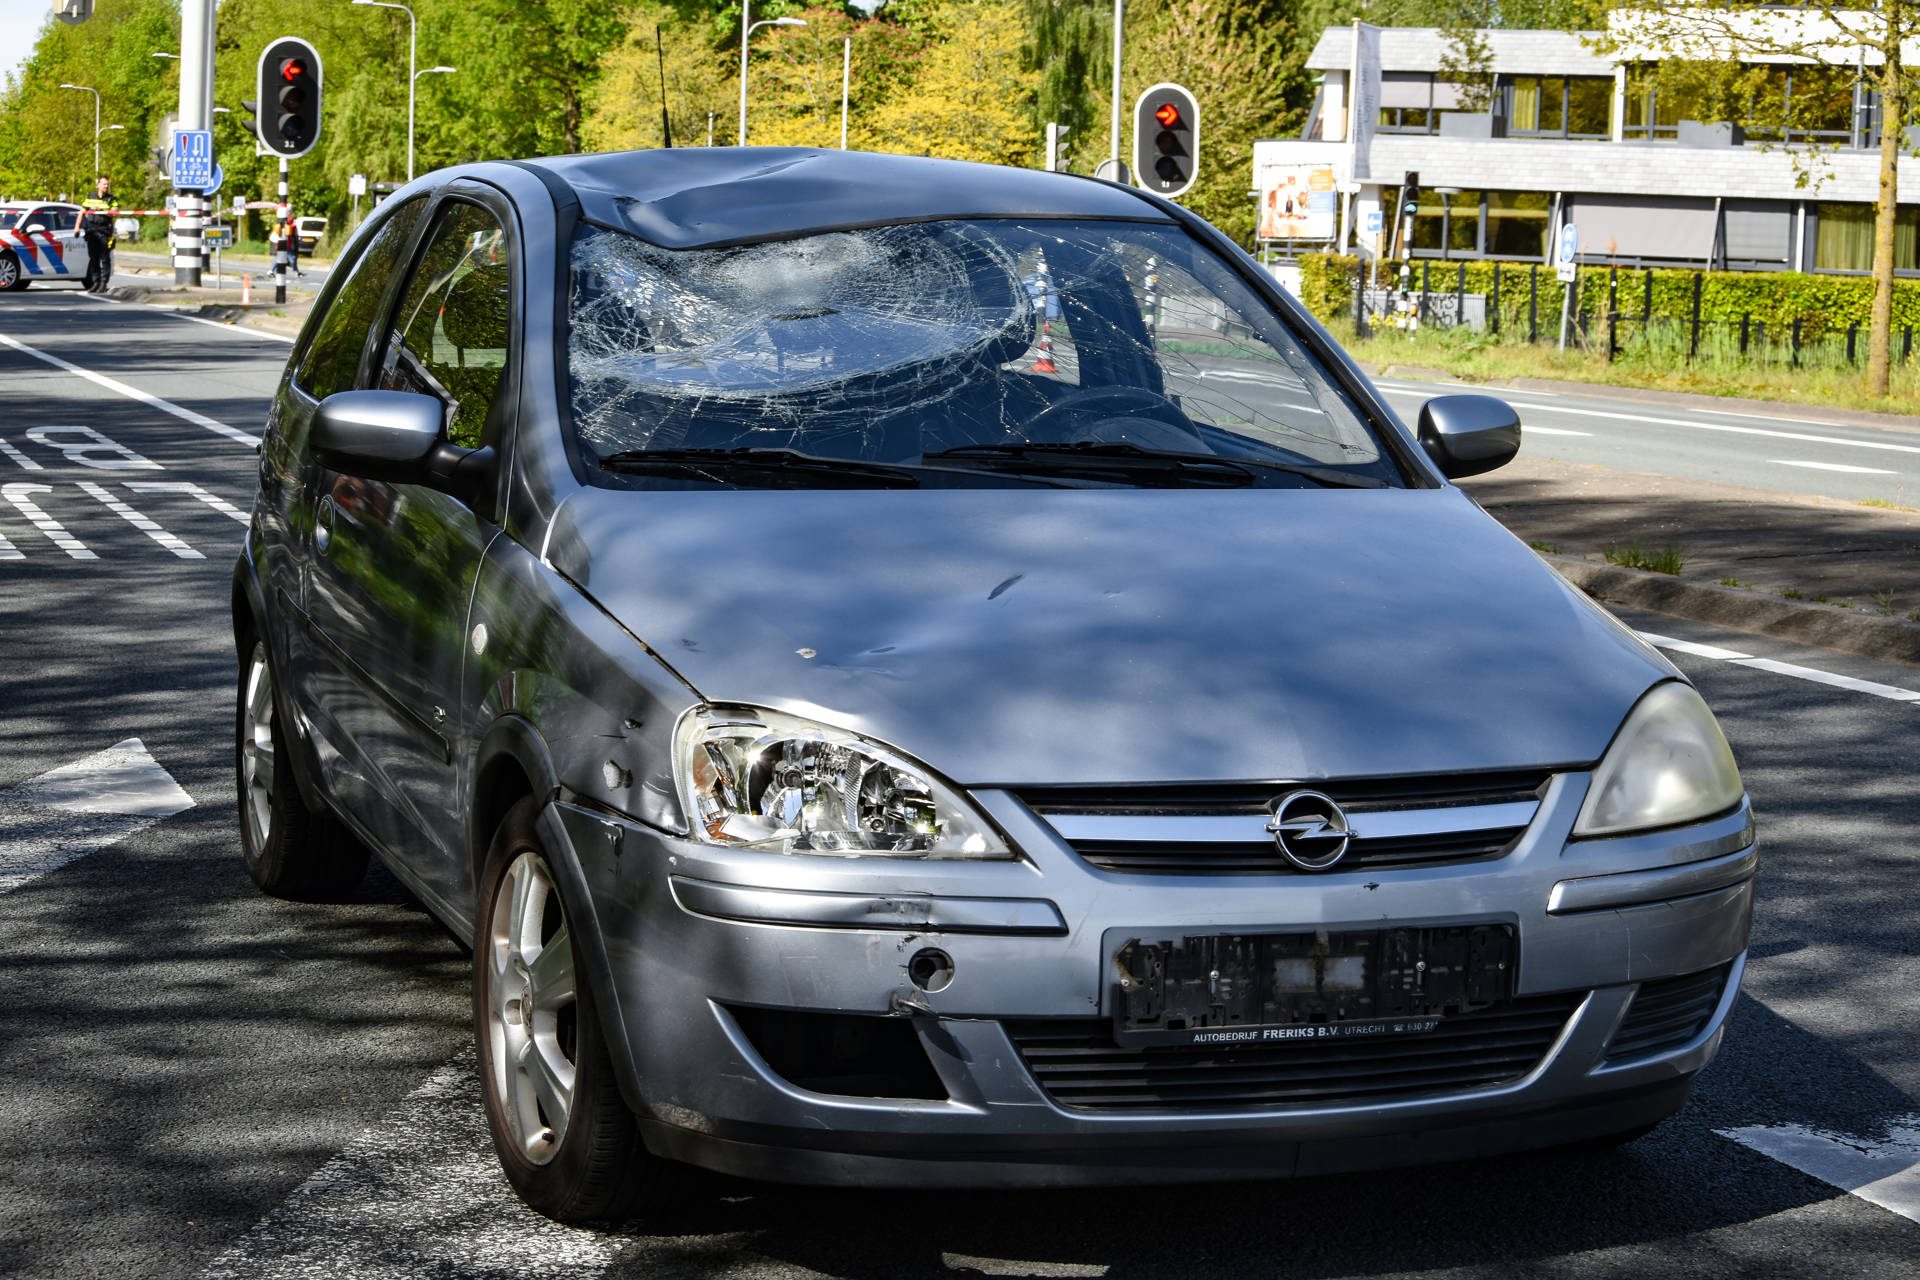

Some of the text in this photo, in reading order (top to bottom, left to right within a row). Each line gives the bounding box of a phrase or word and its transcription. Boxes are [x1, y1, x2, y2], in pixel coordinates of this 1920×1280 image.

[176, 176, 208, 184] LET OP
[0, 482, 252, 559] LIJ
[1193, 1031, 1259, 1042] AUTOBEDRIJF
[1263, 1027, 1315, 1039] FRERIKS
[1344, 1025, 1385, 1035] UTRECHT
